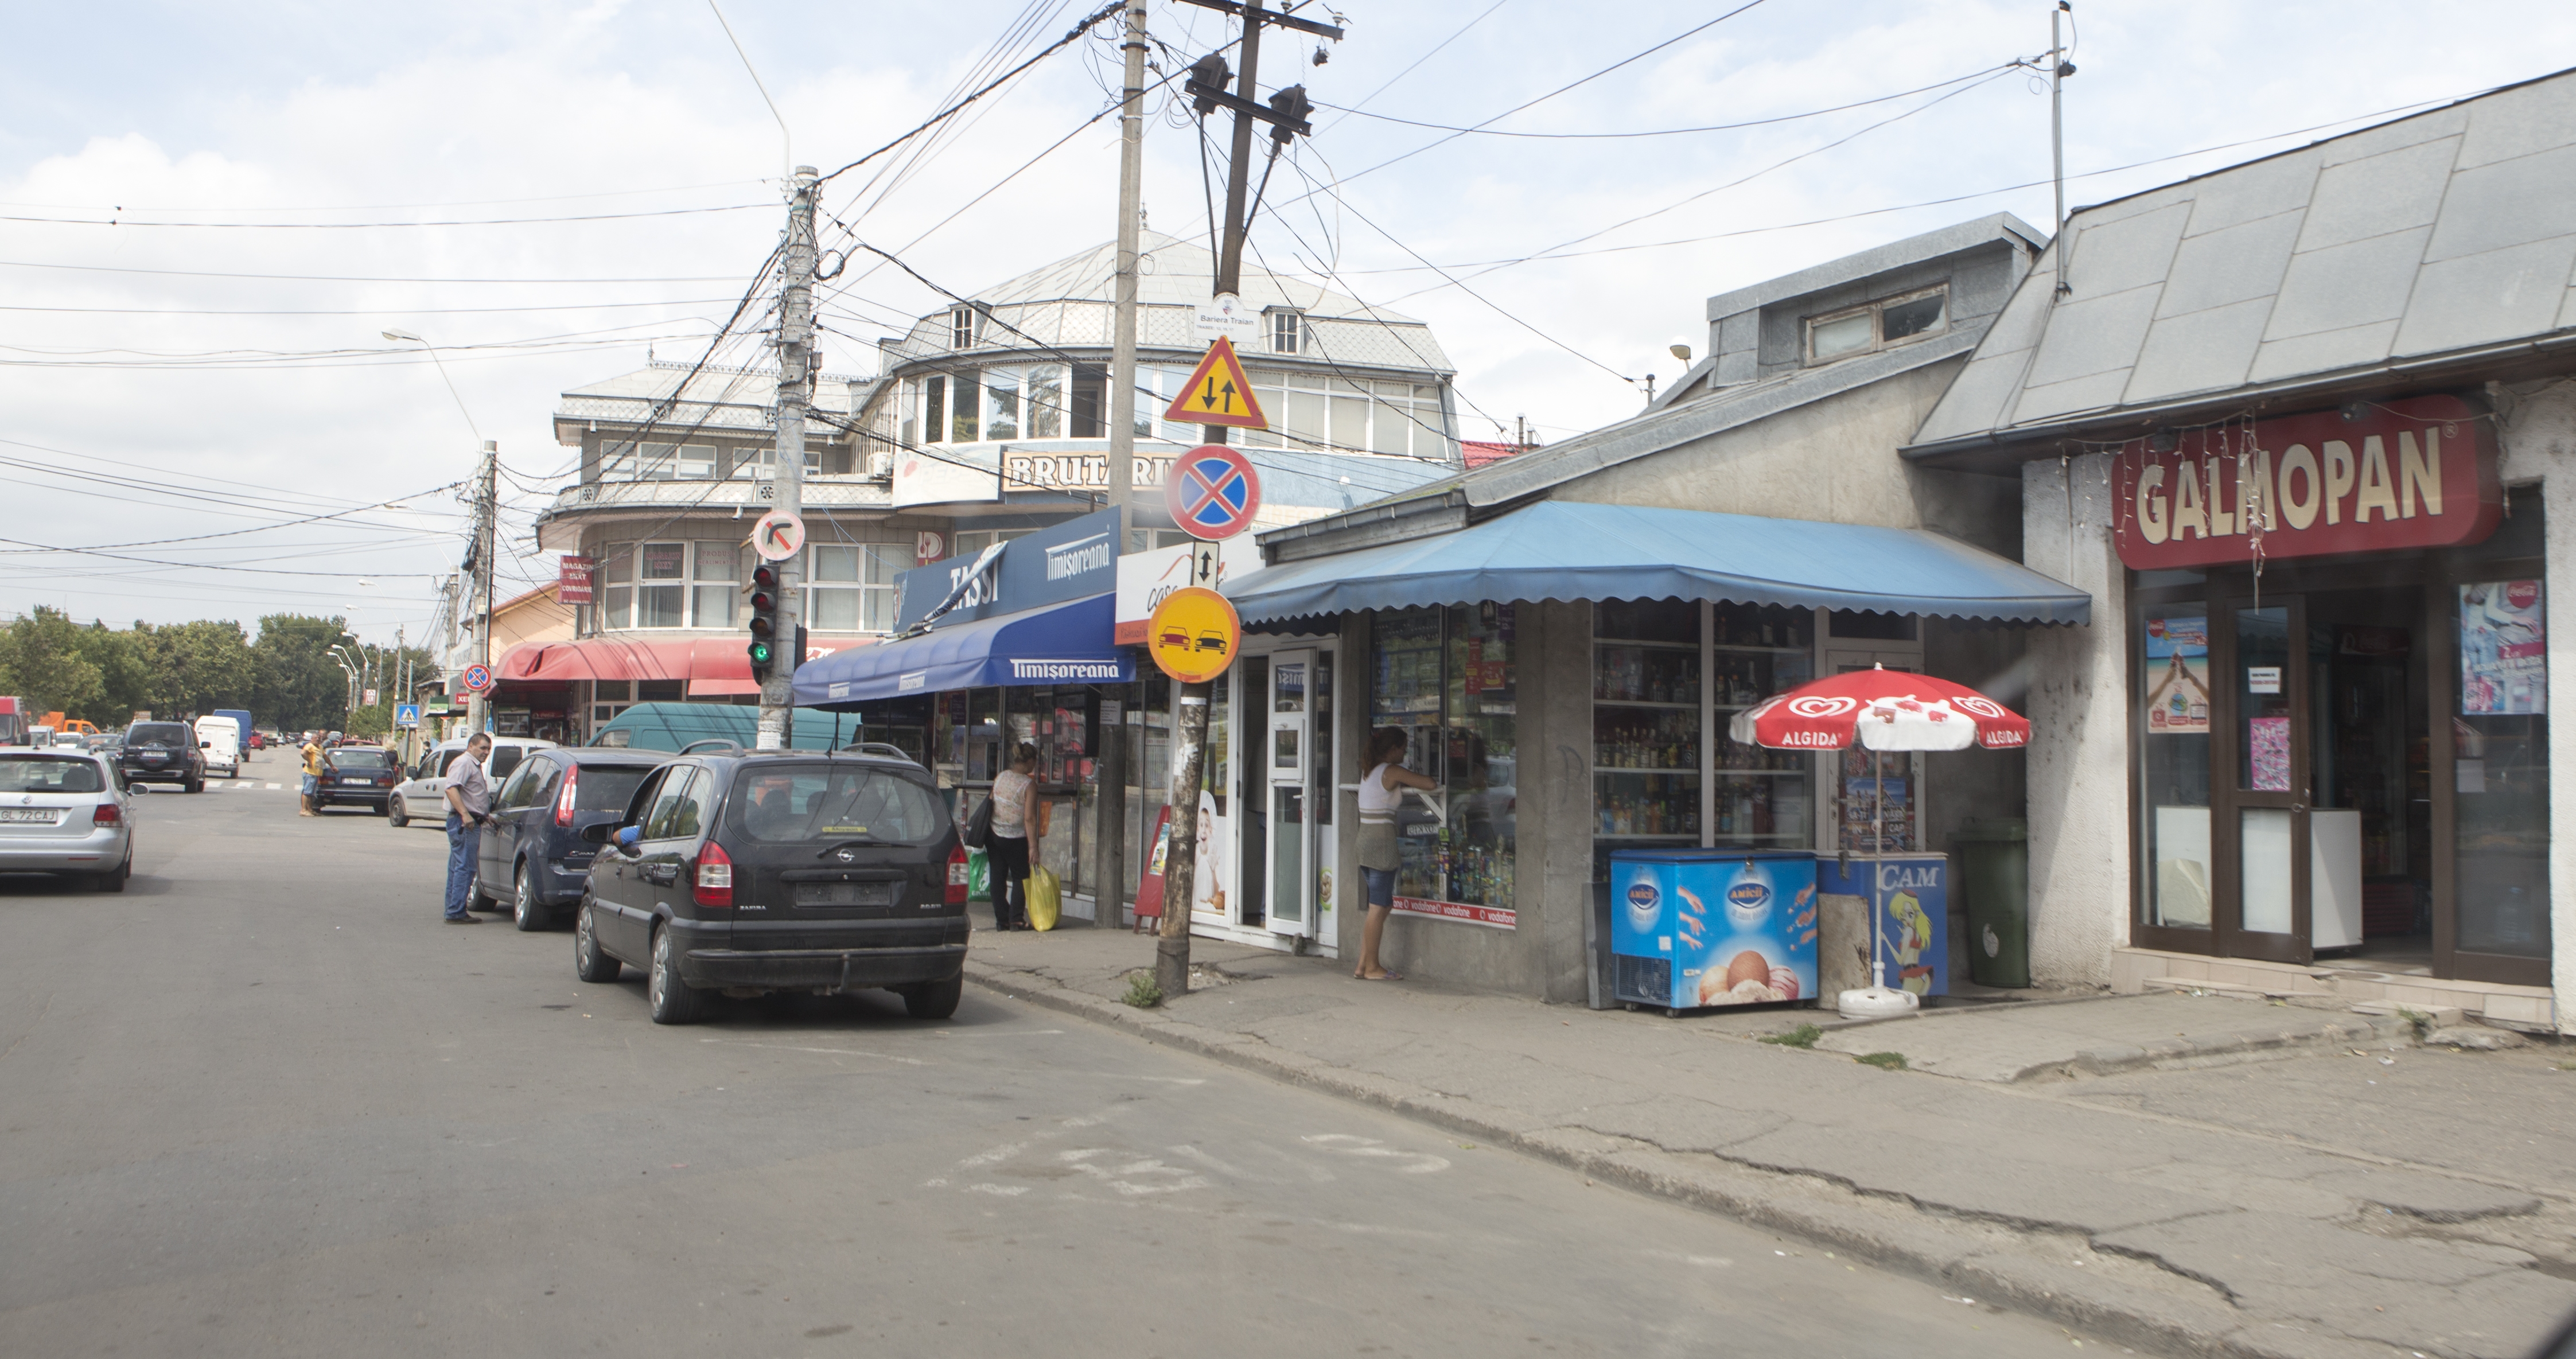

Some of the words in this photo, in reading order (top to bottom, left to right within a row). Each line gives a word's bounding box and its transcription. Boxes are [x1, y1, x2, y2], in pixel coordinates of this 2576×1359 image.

[1200, 315, 1228, 324] Bariera
[1231, 317, 1254, 325] Traian
[1010, 455, 1176, 487] BRUTRI
[2137, 426, 2443, 544] GALMOPAN
[563, 563, 594, 571] MAGAZIN
[1781, 731, 1839, 746] ALGIDA
[1986, 730, 2022, 745] ALGIDA
[1, 811, 15, 819] GL
[20, 811, 33, 819] 72
[34, 811, 55, 820] CAJ
[1880, 865, 1939, 891] CAM
[1411, 901, 1437, 913] vodafone
[1443, 905, 1470, 918] vodafone
[1488, 912, 1516, 924] vodafone
